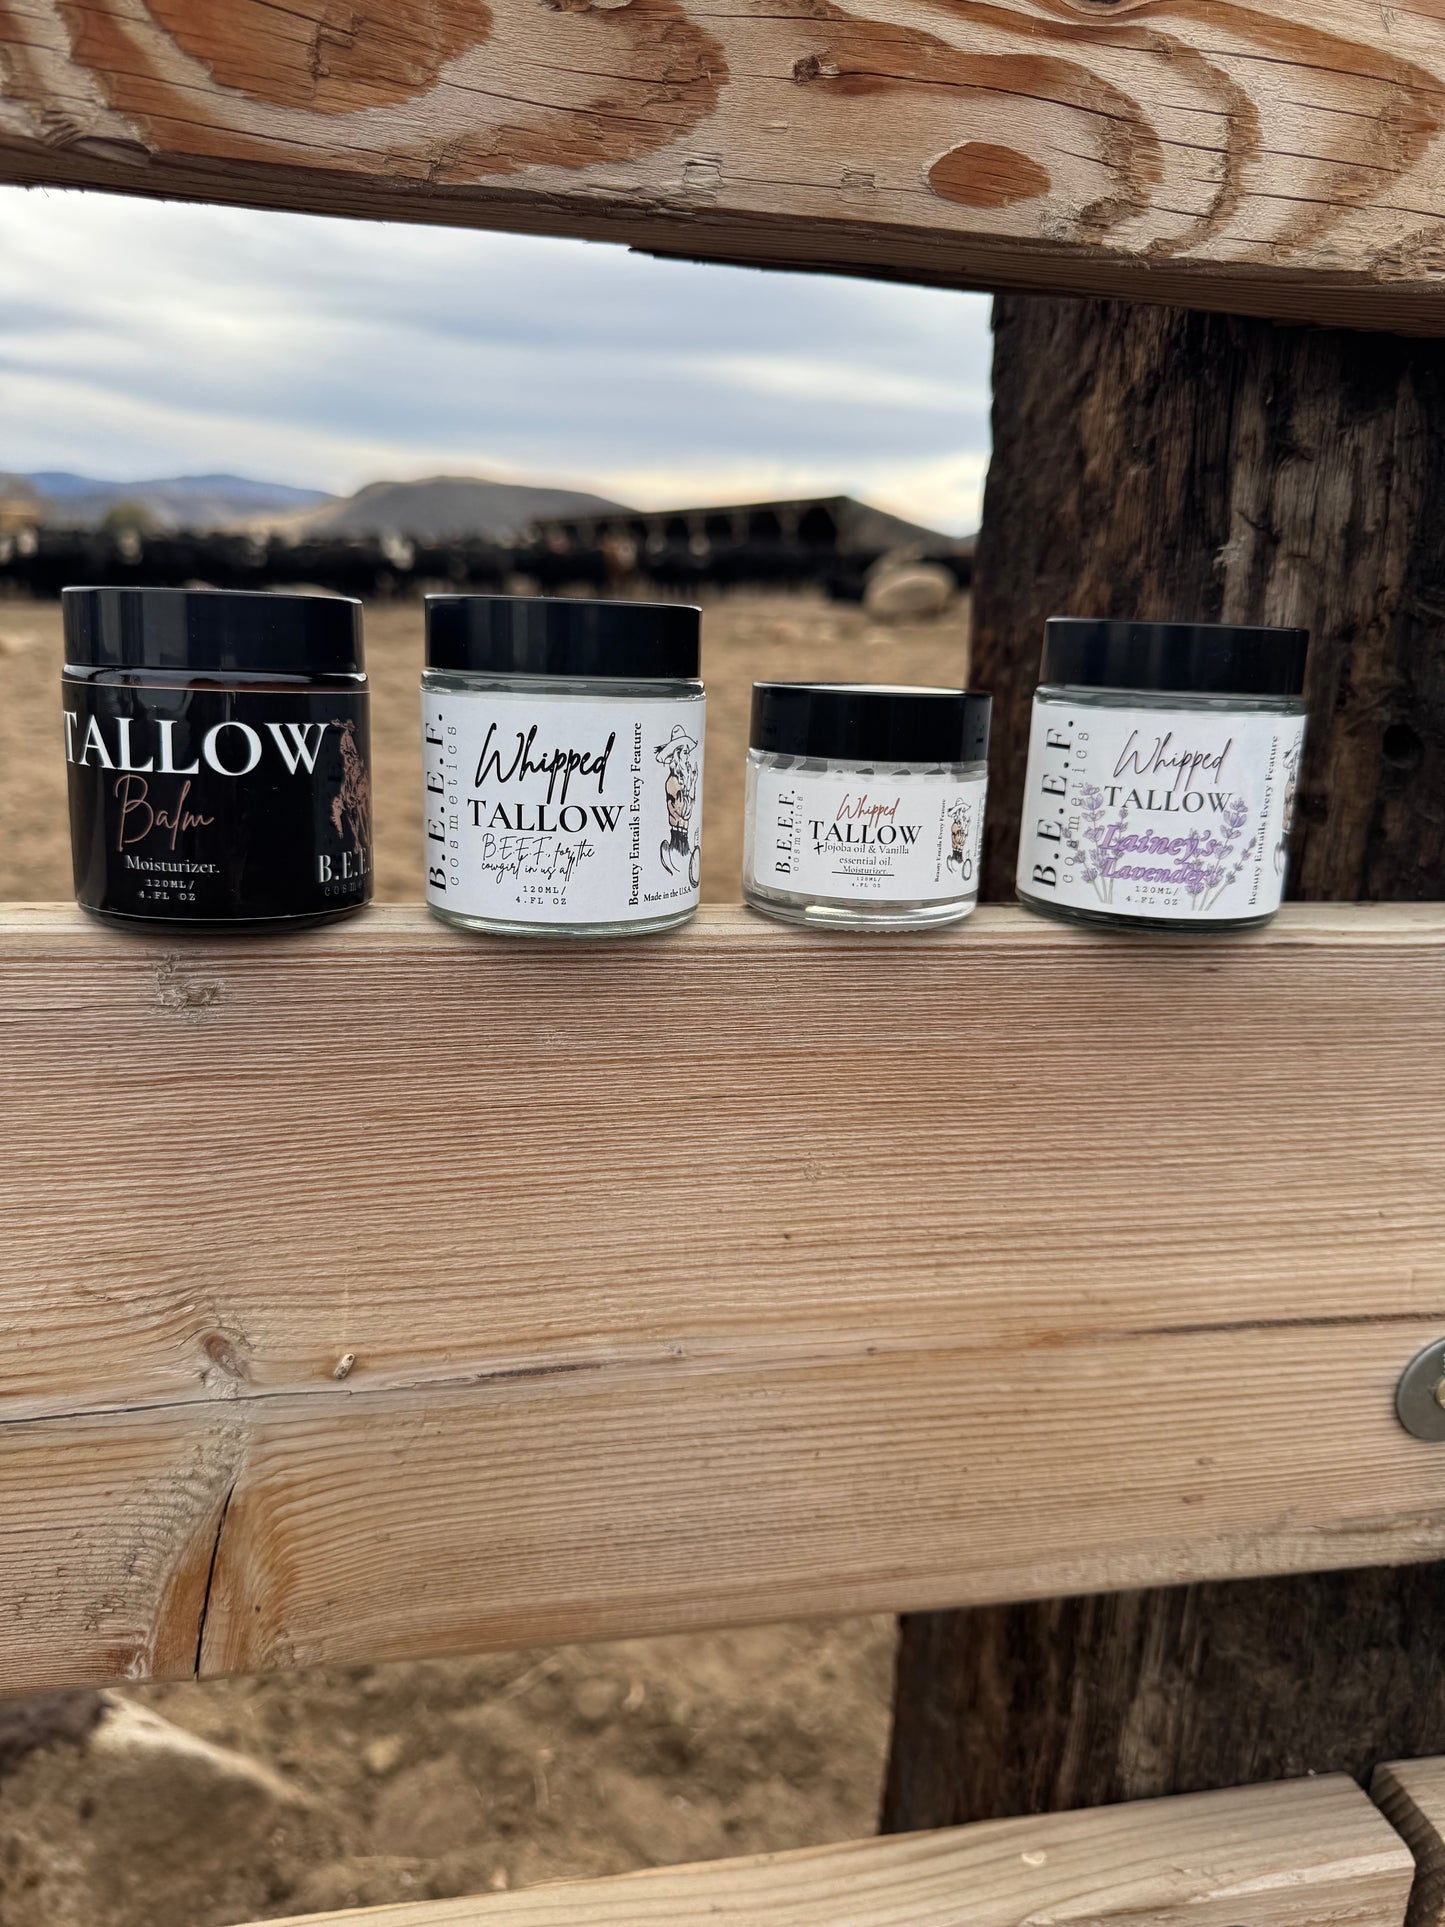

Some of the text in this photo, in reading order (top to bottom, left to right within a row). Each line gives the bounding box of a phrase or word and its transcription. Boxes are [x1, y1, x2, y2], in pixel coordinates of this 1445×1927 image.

[63, 710, 331, 776] TALLOW
[474, 722, 616, 804] Whipped
[1113, 730, 1233, 791] Whipped
[114, 774, 215, 852] Balm
[425, 713, 447, 894] B.E.E.F.
[447, 726, 460, 886] cosmetics
[628, 722, 644, 906] Beauty Entails Every Feature
[835, 793, 901, 828] Whipped
[1032, 720, 1074, 888] B.E.E.F.
[1062, 731, 1090, 884] cosmetics
[1104, 785, 1233, 813] TALLOW
[467, 799, 625, 833] TALLOW
[1248, 735, 1279, 906] Beauty Entails Every Feature
[775, 790, 795, 875] B.E.E.F.
[808, 820, 923, 845] TALLOW
[1100, 825, 1218, 865] Lainey's
[573, 839, 595, 867] the
[839, 856, 893, 866] essential oil.
[853, 843, 866, 853] oil
[868, 845, 877, 854] &
[879, 845, 910, 854] Vanilla
[125, 854, 221, 874] Moisturizer.
[481, 854, 529, 884] cowgirl
[525, 864, 538, 874] in
[1100, 857, 1211, 885] Lavender
[145, 879, 195, 890] 120ML/
[179, 892, 196, 902] OZ
[523, 885, 566, 896] 120ML/
[643, 892, 662, 903] Made
[663, 891, 670, 900] in
[670, 888, 679, 898] the
[1135, 885, 1179, 896] 120ML/
[552, 897, 567, 905] OZ
[1164, 897, 1179, 906] OZ
